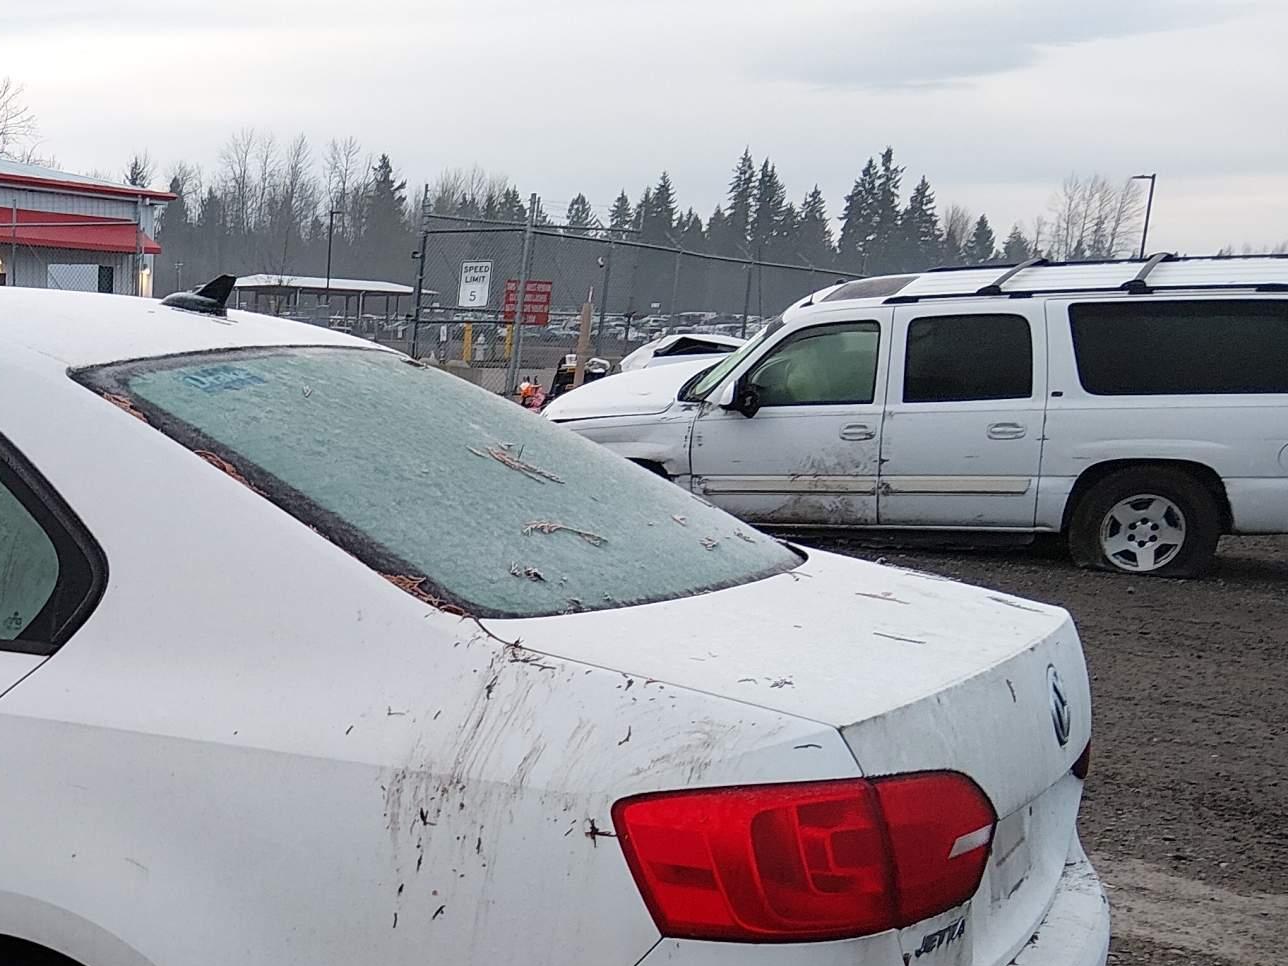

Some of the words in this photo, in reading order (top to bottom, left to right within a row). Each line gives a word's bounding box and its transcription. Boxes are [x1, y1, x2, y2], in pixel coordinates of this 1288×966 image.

[464, 265, 489, 273] SPEED
[469, 290, 477, 302] 5
[915, 915, 965, 958] JETTA
